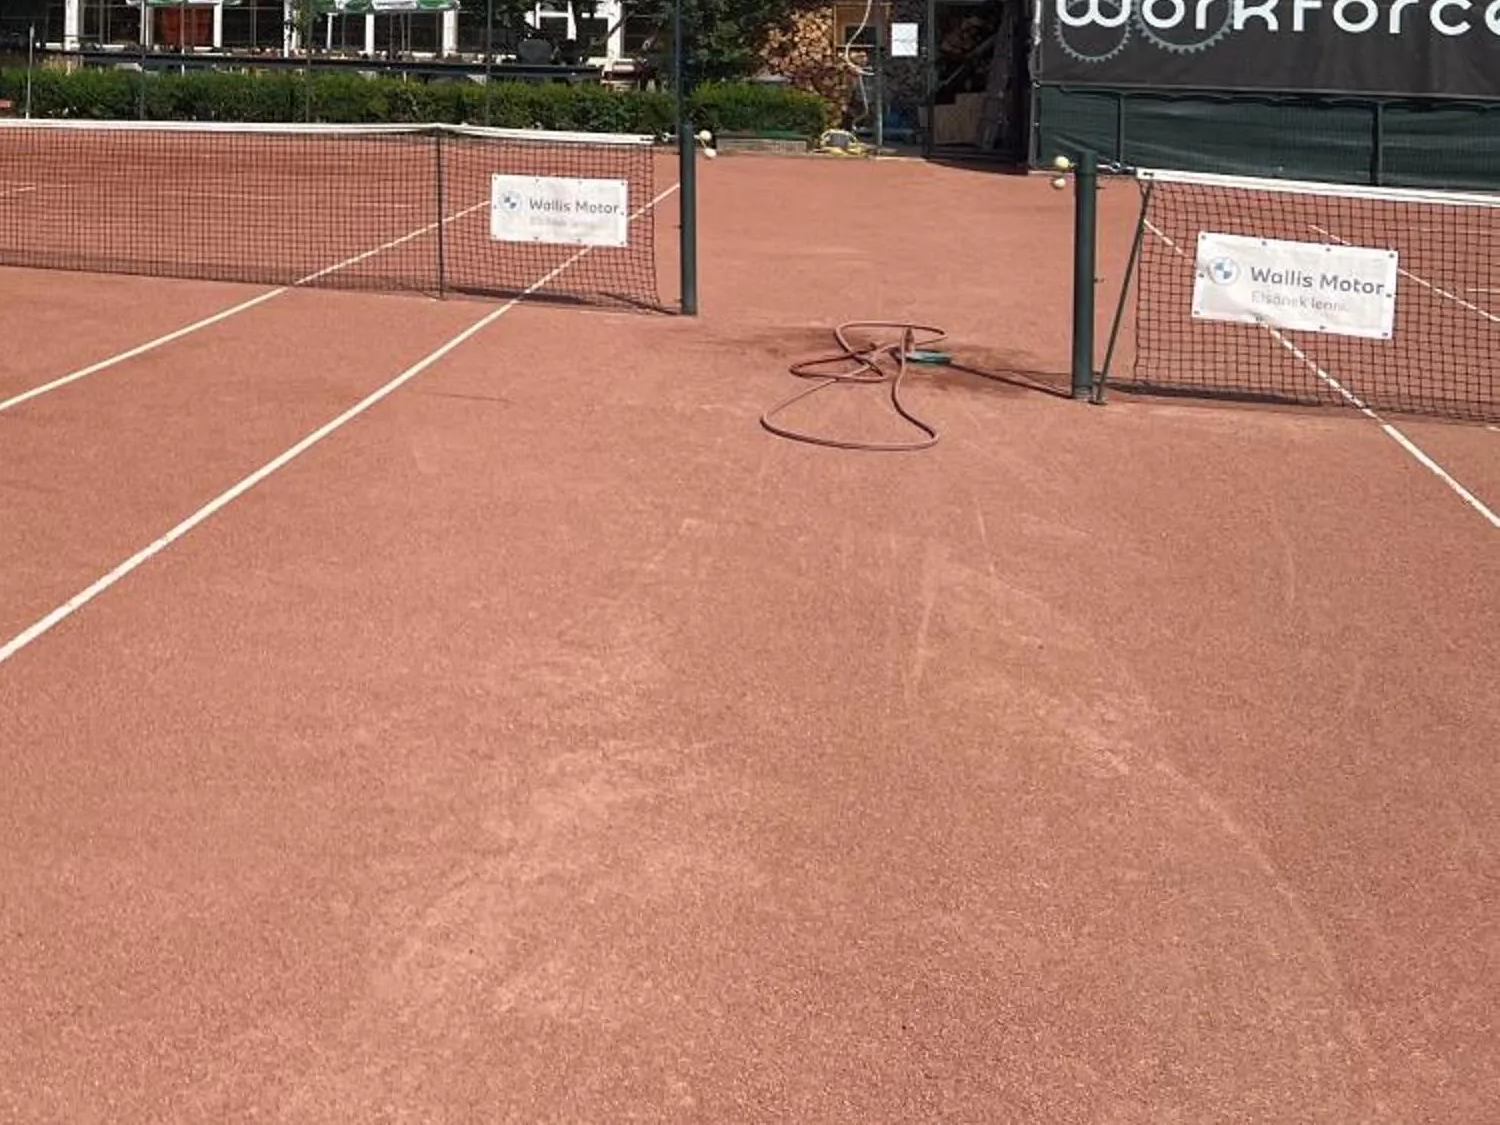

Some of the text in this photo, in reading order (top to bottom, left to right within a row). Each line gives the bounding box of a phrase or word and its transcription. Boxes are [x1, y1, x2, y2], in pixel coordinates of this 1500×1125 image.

[529, 197, 620, 214] Wallis Motor
[1250, 266, 1385, 295] Wallis Motor
